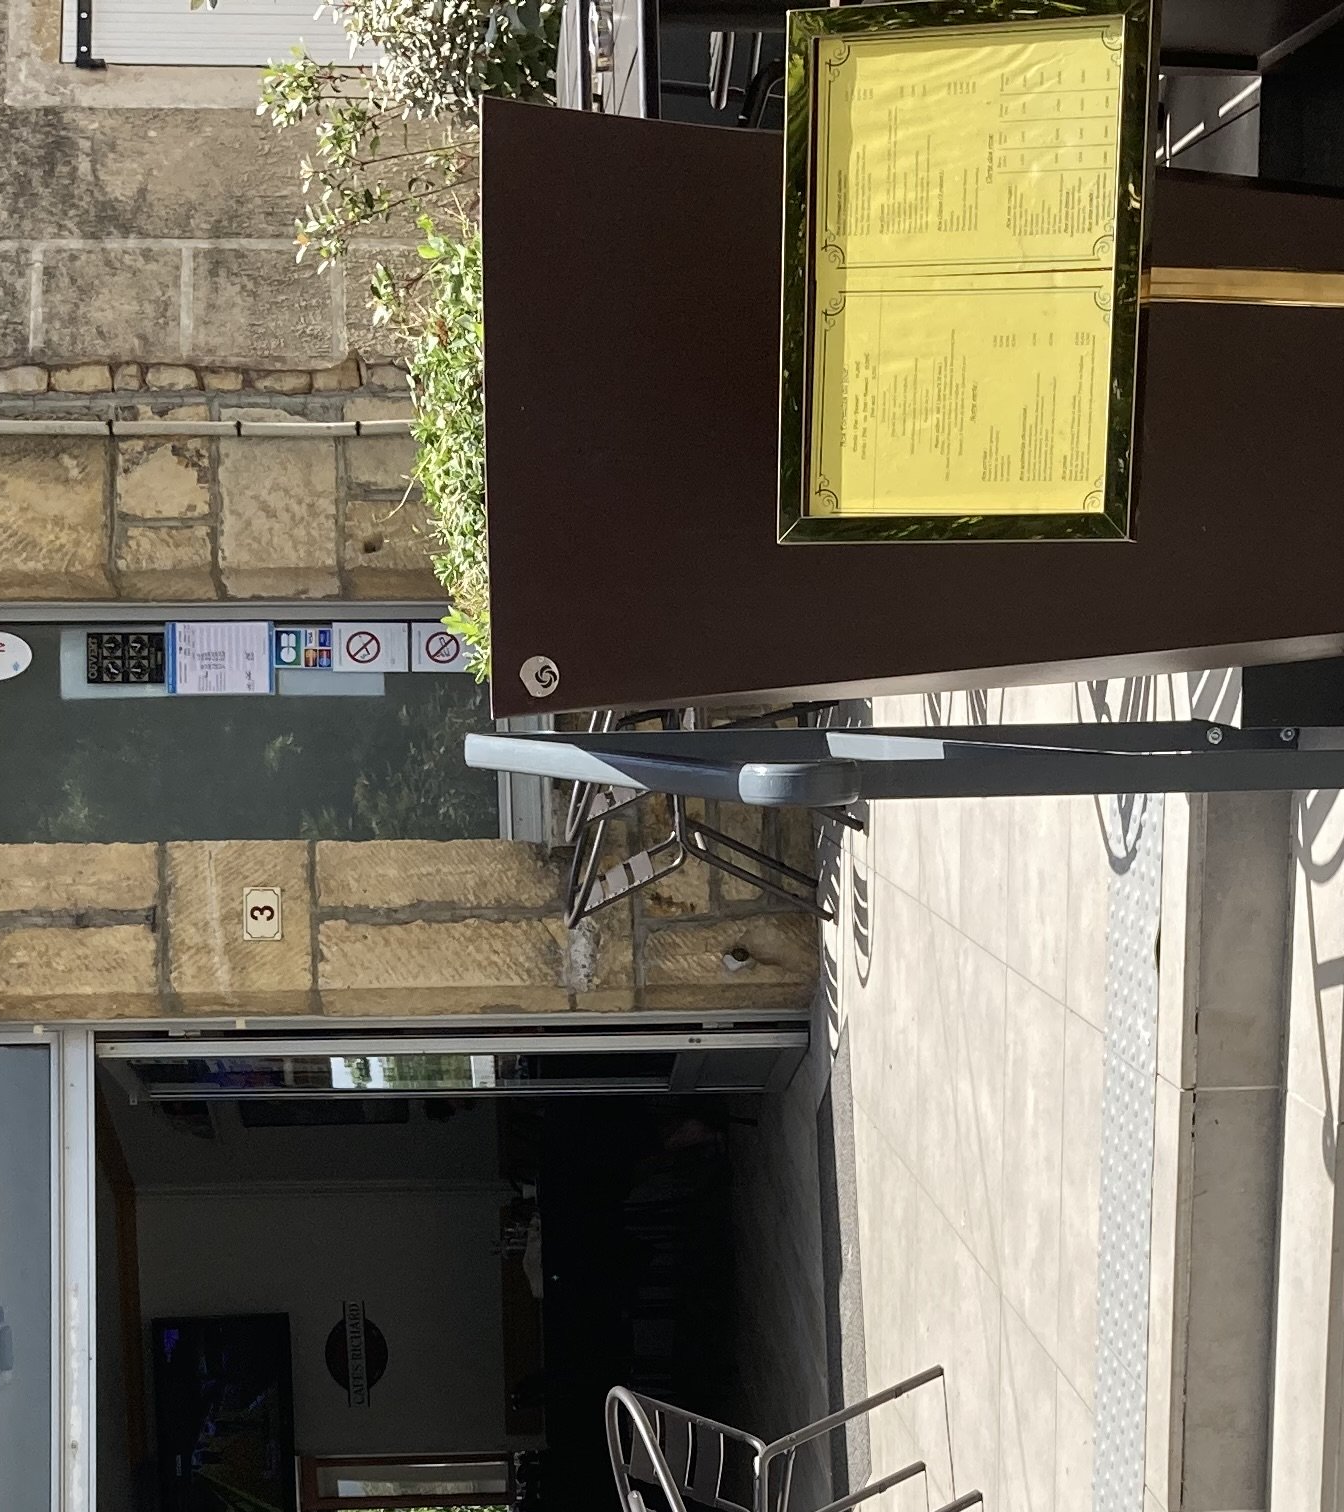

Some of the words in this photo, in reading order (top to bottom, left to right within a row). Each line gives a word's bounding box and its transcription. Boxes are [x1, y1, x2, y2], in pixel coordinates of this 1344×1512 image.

[88, 637, 98, 679] OUVERT
[250, 905, 275, 921] 3
[347, 1303, 362, 1360] RICHARD
